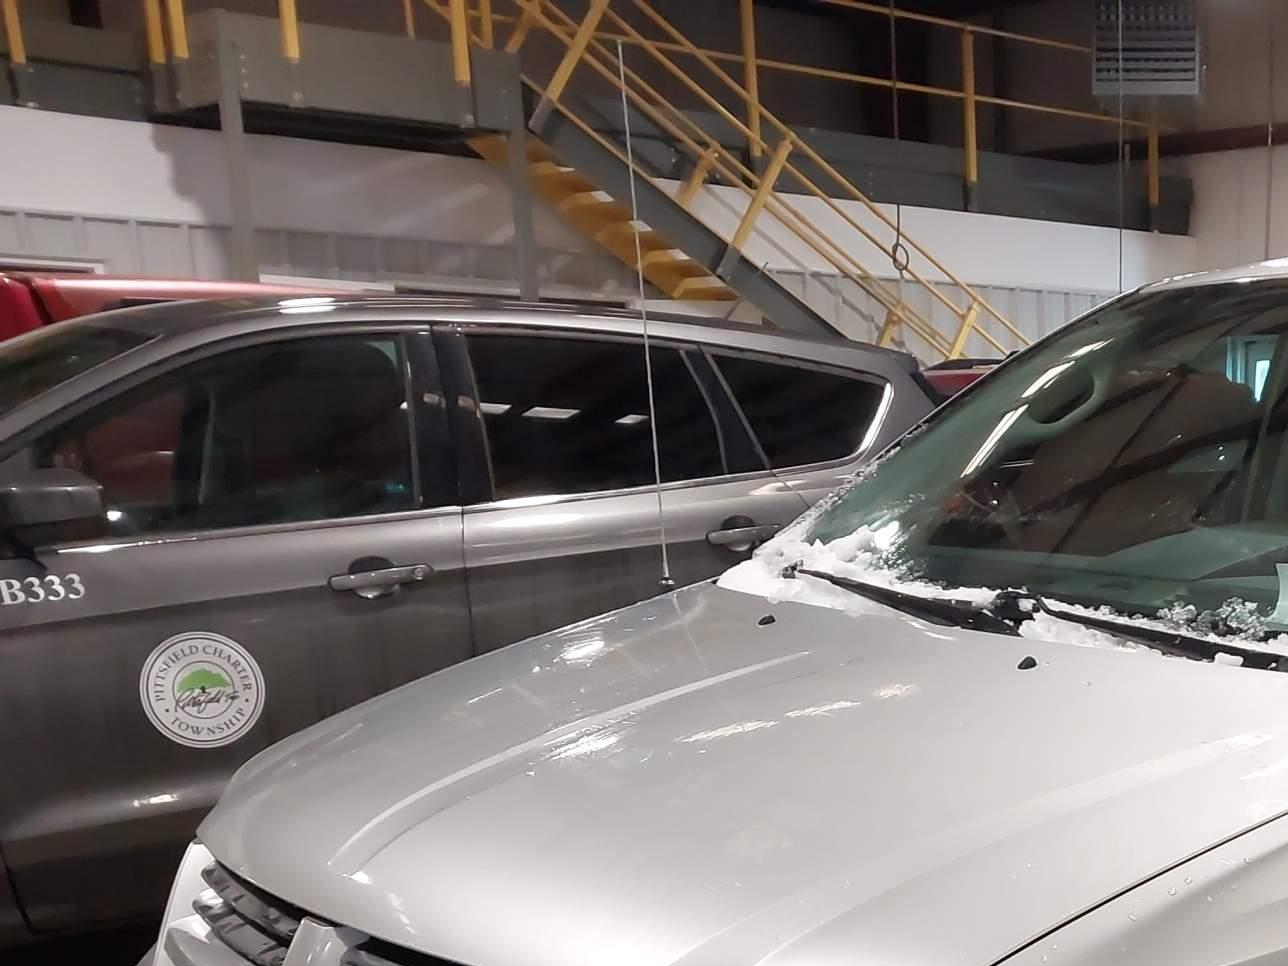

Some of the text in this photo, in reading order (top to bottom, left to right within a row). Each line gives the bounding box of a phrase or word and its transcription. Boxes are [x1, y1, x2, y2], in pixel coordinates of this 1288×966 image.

[0, 573, 85, 605] B333
[153, 644, 252, 702] PITTSFIELD CHARTER
[170, 706, 246, 736] TOWNSHIP
